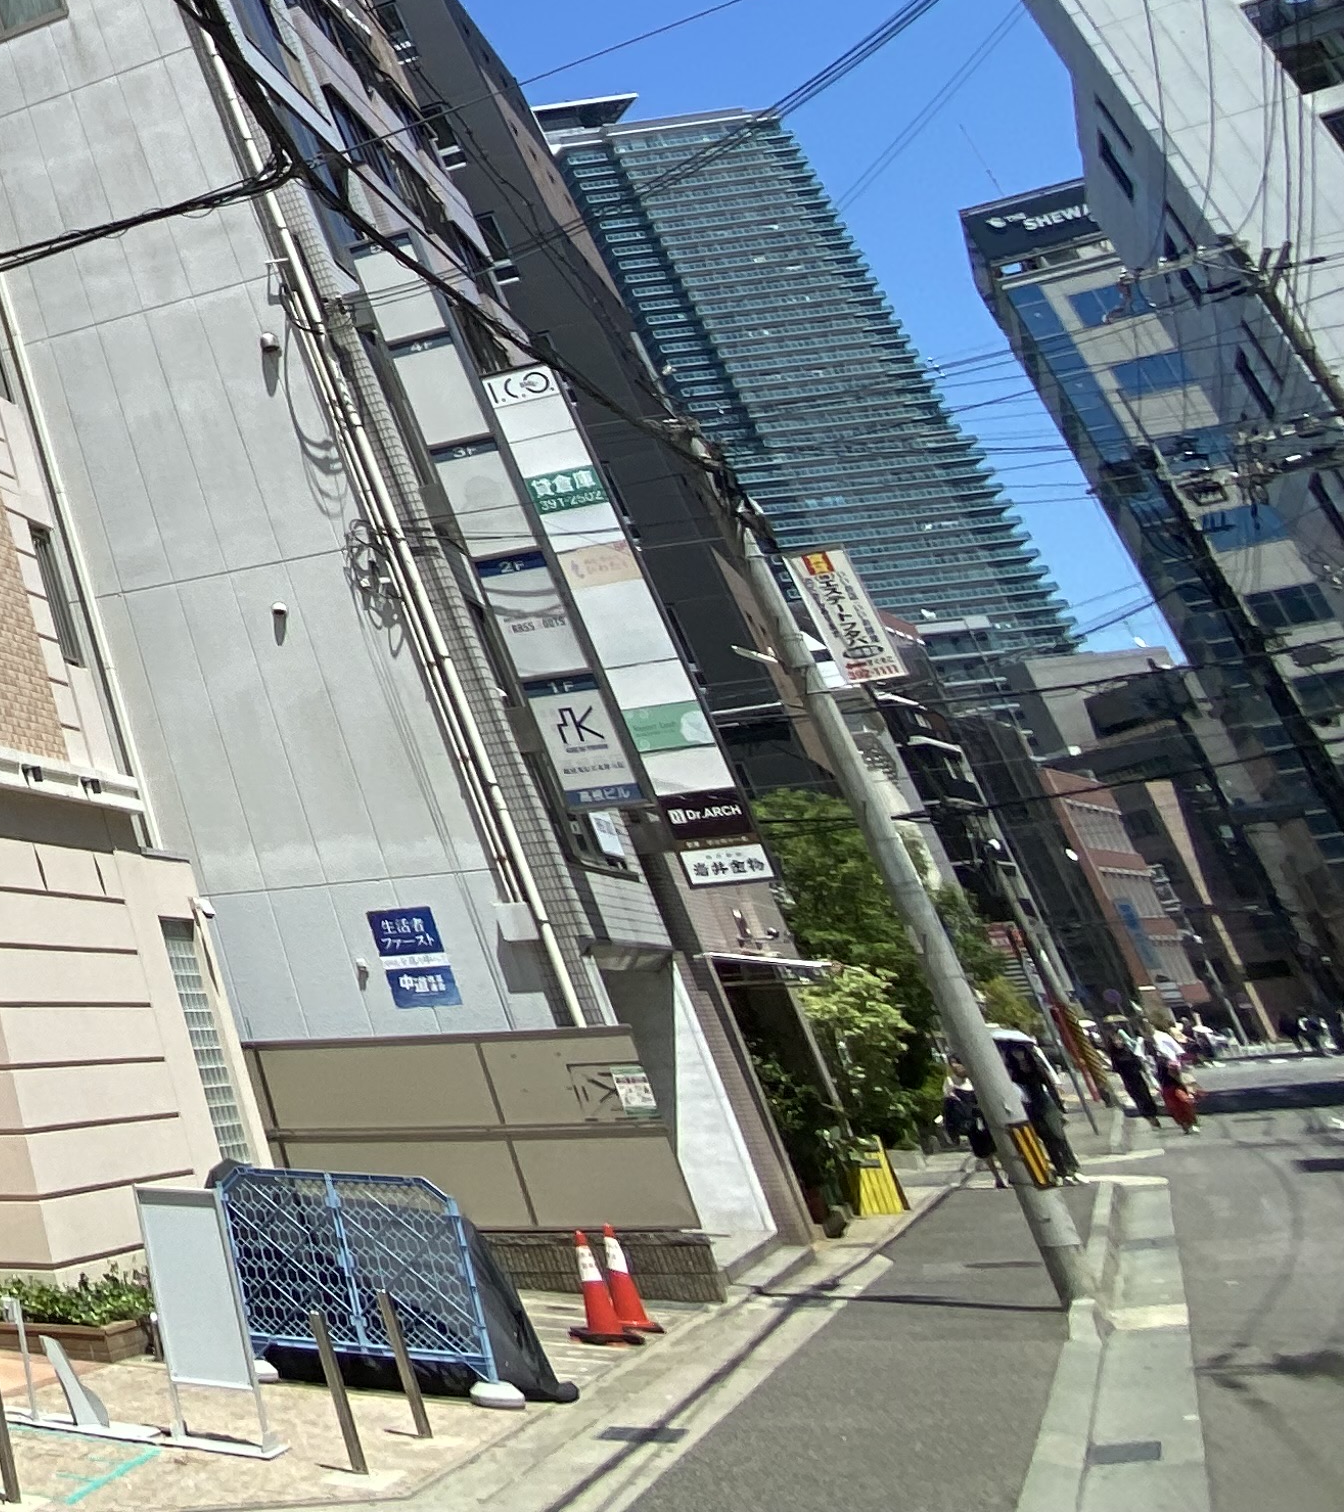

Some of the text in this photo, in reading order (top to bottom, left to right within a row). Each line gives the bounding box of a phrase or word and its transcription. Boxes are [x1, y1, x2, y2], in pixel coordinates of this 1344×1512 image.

[685, 804, 743, 821] Dr.ARCH
[380, 917, 426, 935] 生活者
[380, 932, 435, 950] ファースト
